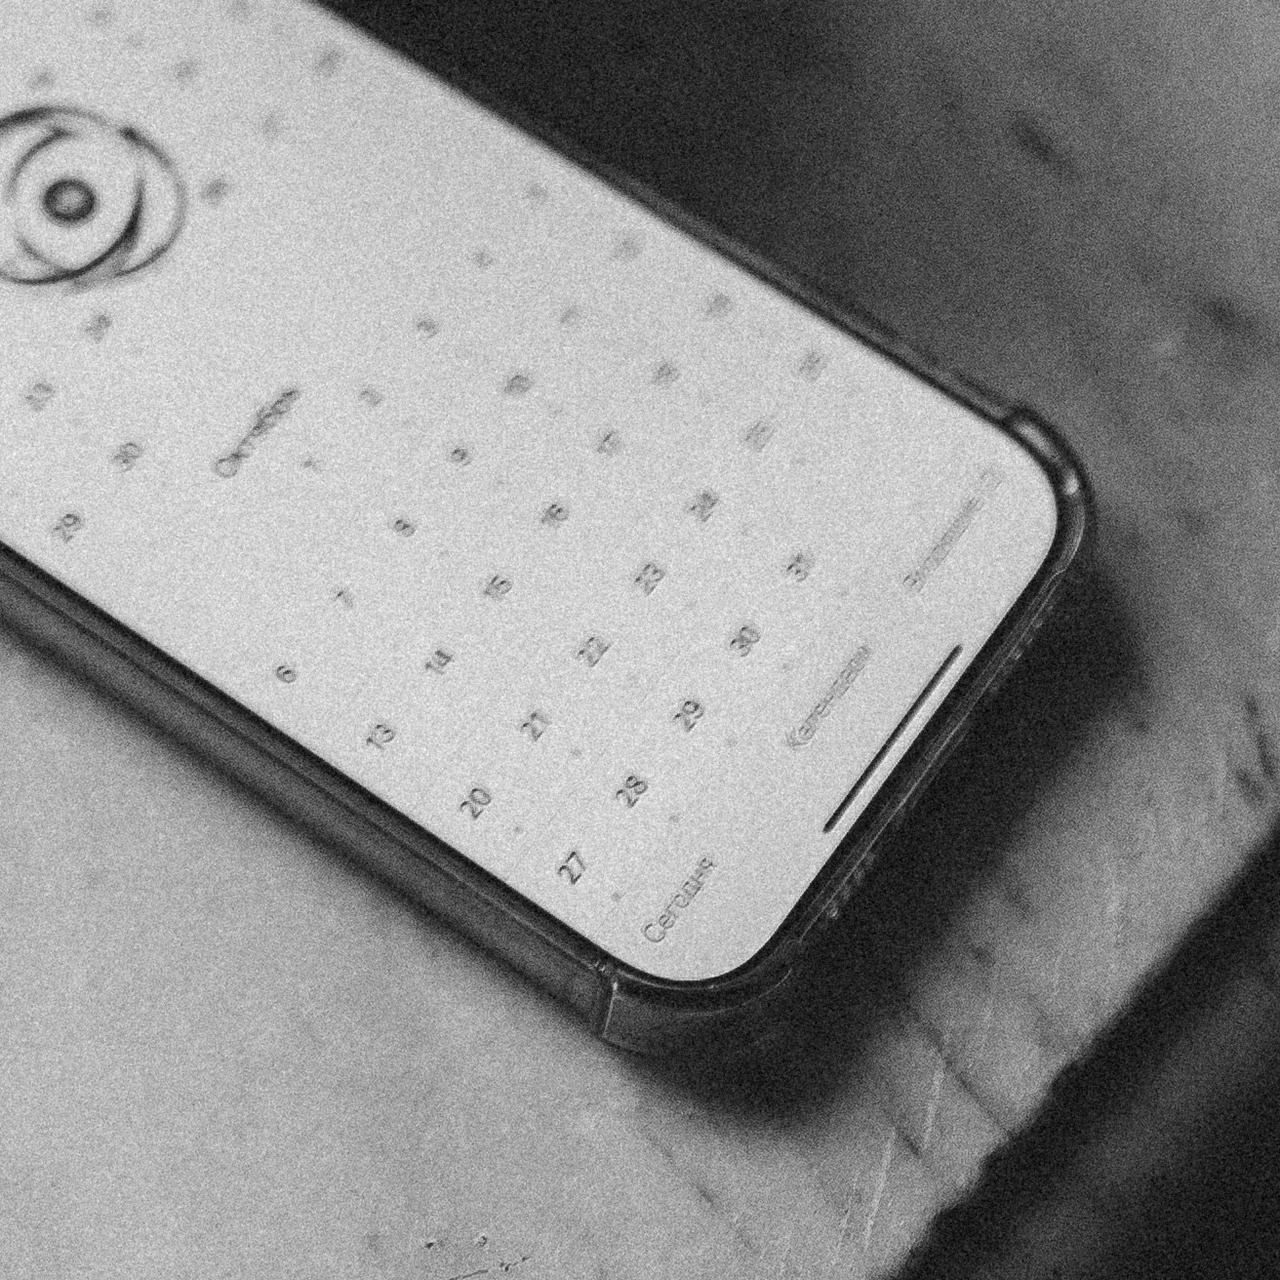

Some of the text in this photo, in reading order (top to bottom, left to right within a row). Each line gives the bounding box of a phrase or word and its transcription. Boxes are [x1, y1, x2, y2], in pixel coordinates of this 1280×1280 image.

[213, 387, 300, 478] Октябрь
[52, 440, 144, 543] 29 30
[273, 663, 298, 684] 6
[364, 721, 397, 750] 13
[423, 647, 454, 674] 14
[481, 573, 513, 600] 15
[539, 501, 569, 526] 16
[458, 785, 493, 821] 20
[518, 709, 549, 743] 21
[575, 634, 611, 668] 22
[632, 561, 667, 595] 23
[556, 552, 813, 886] 27 28 29 30 31
[642, 855, 717, 943] Сегодня
